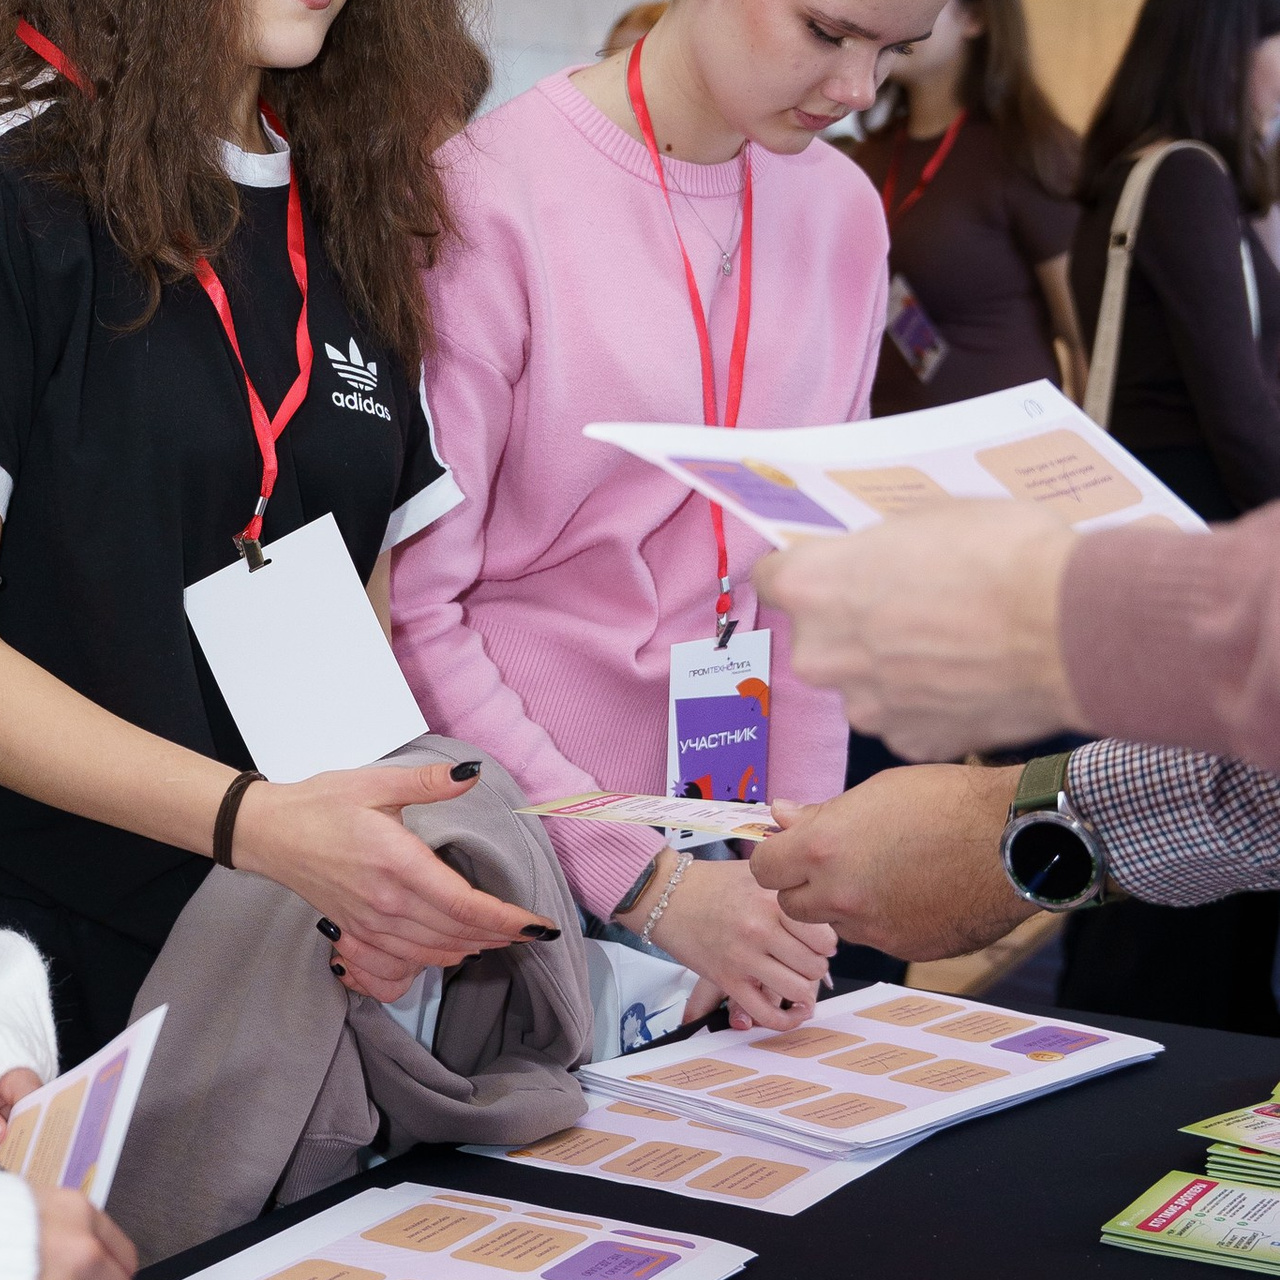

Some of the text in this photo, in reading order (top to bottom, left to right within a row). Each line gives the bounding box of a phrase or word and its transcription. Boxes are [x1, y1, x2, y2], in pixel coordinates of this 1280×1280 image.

[332, 391, 392, 421] adidas
[679, 726, 758, 754] УЧАСТНИК
[1148, 1216, 1166, 1228] КТО
[1158, 1204, 1183, 1219] ТАКИЕ
